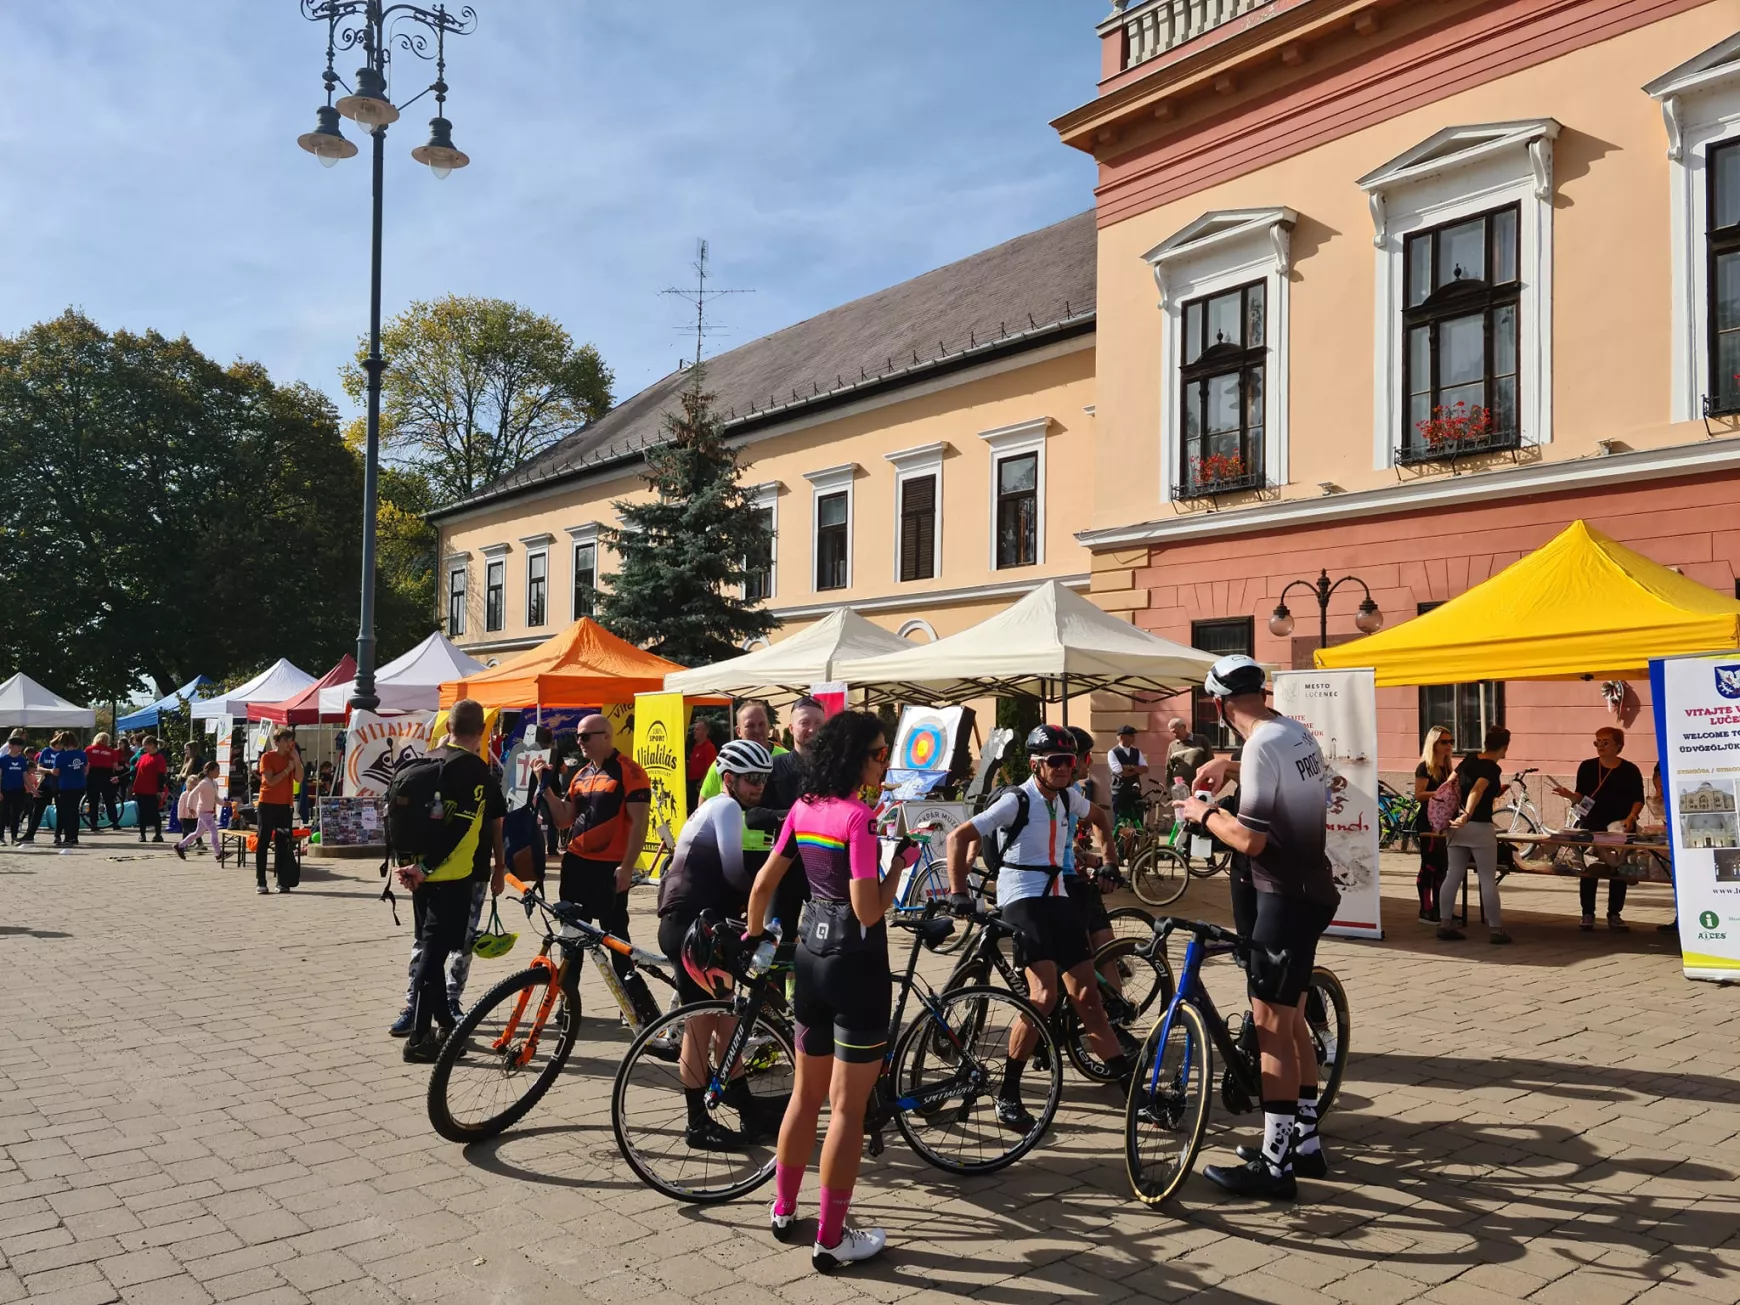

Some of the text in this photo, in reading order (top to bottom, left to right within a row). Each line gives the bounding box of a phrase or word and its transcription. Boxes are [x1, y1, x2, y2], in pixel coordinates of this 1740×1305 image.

[1684, 706, 1733, 716] VITAJTE
[1710, 714, 1740, 725] LUČE
[1683, 731, 1730, 740] WELCOME
[1679, 743, 1740, 753] ÜDVÖZÖLJÜK
[637, 744, 677, 769] Vitalitás
[720, 1023, 745, 1080] SPECIALIZED
[923, 1085, 975, 1104] SPECIALIZED
